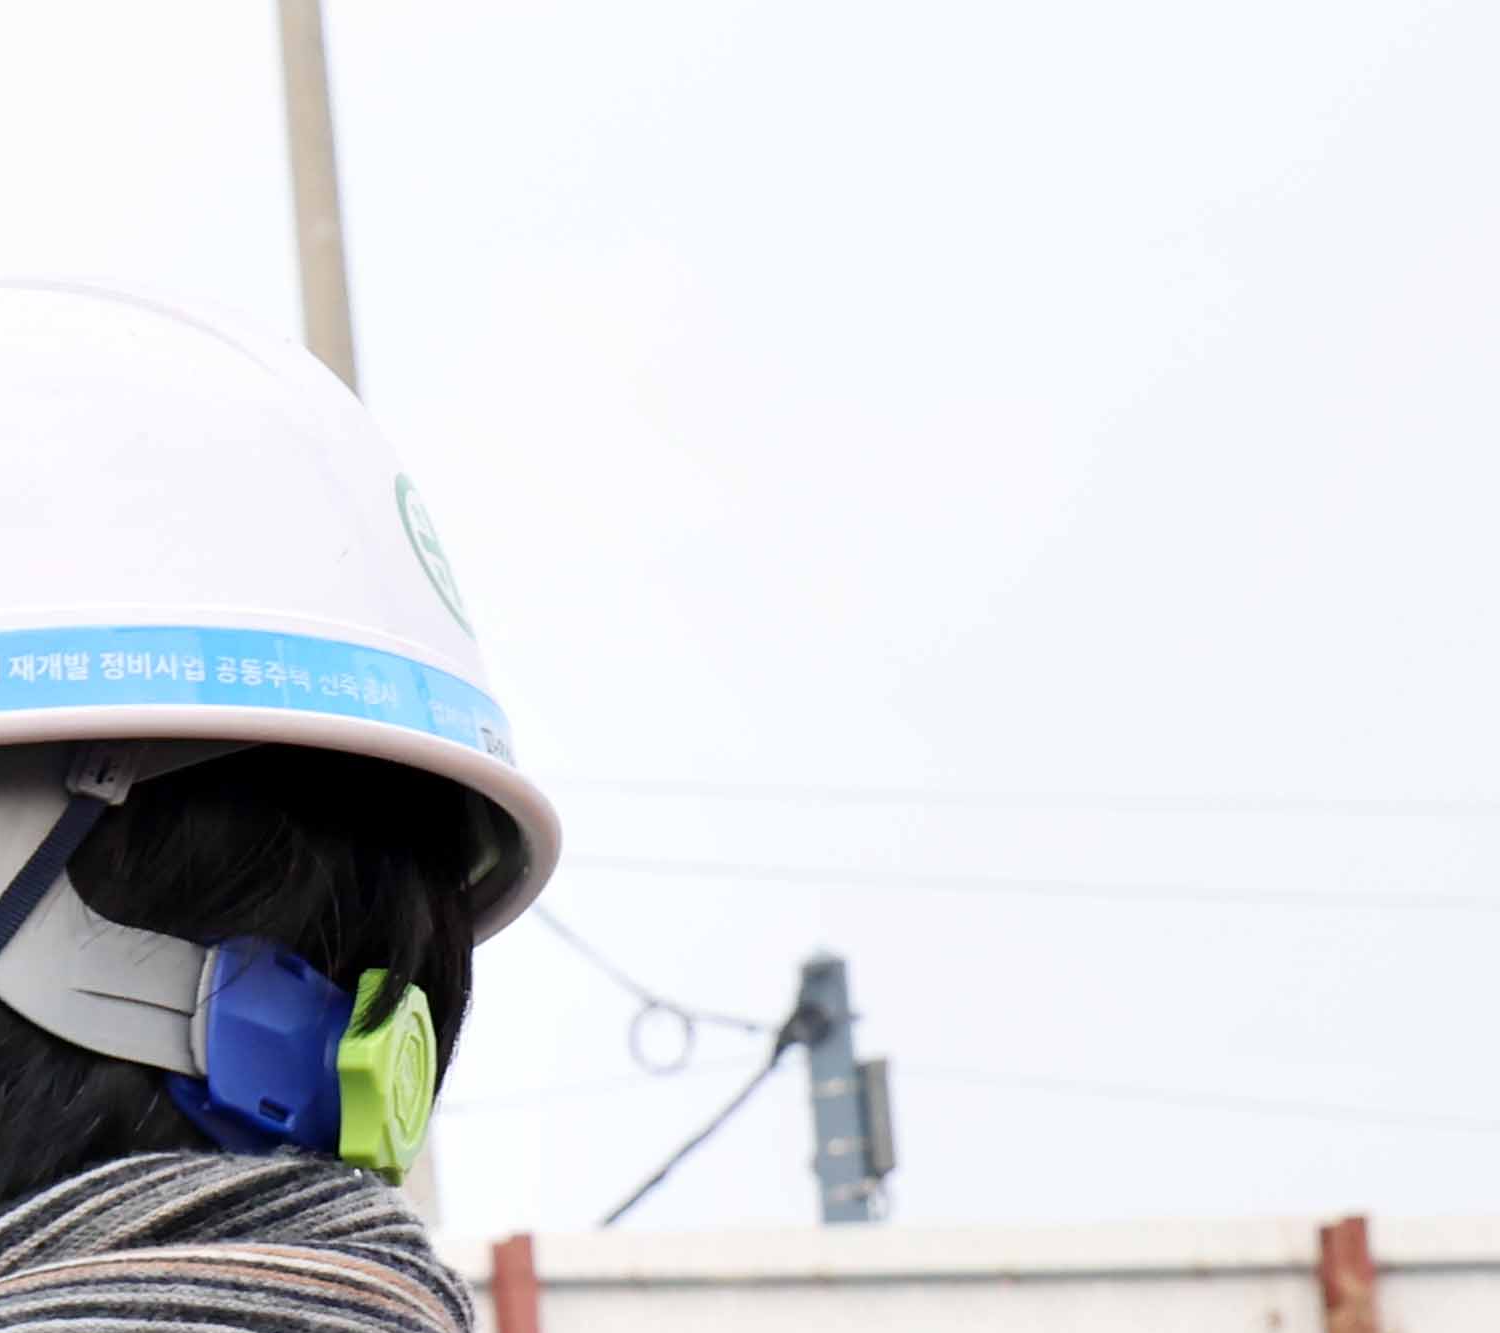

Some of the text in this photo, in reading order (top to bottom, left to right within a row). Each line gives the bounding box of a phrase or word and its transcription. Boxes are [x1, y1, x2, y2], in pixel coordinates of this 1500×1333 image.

[8, 651, 90, 683] 재개발
[99, 652, 206, 683] 정비사업
[216, 655, 312, 694] 공동주택
